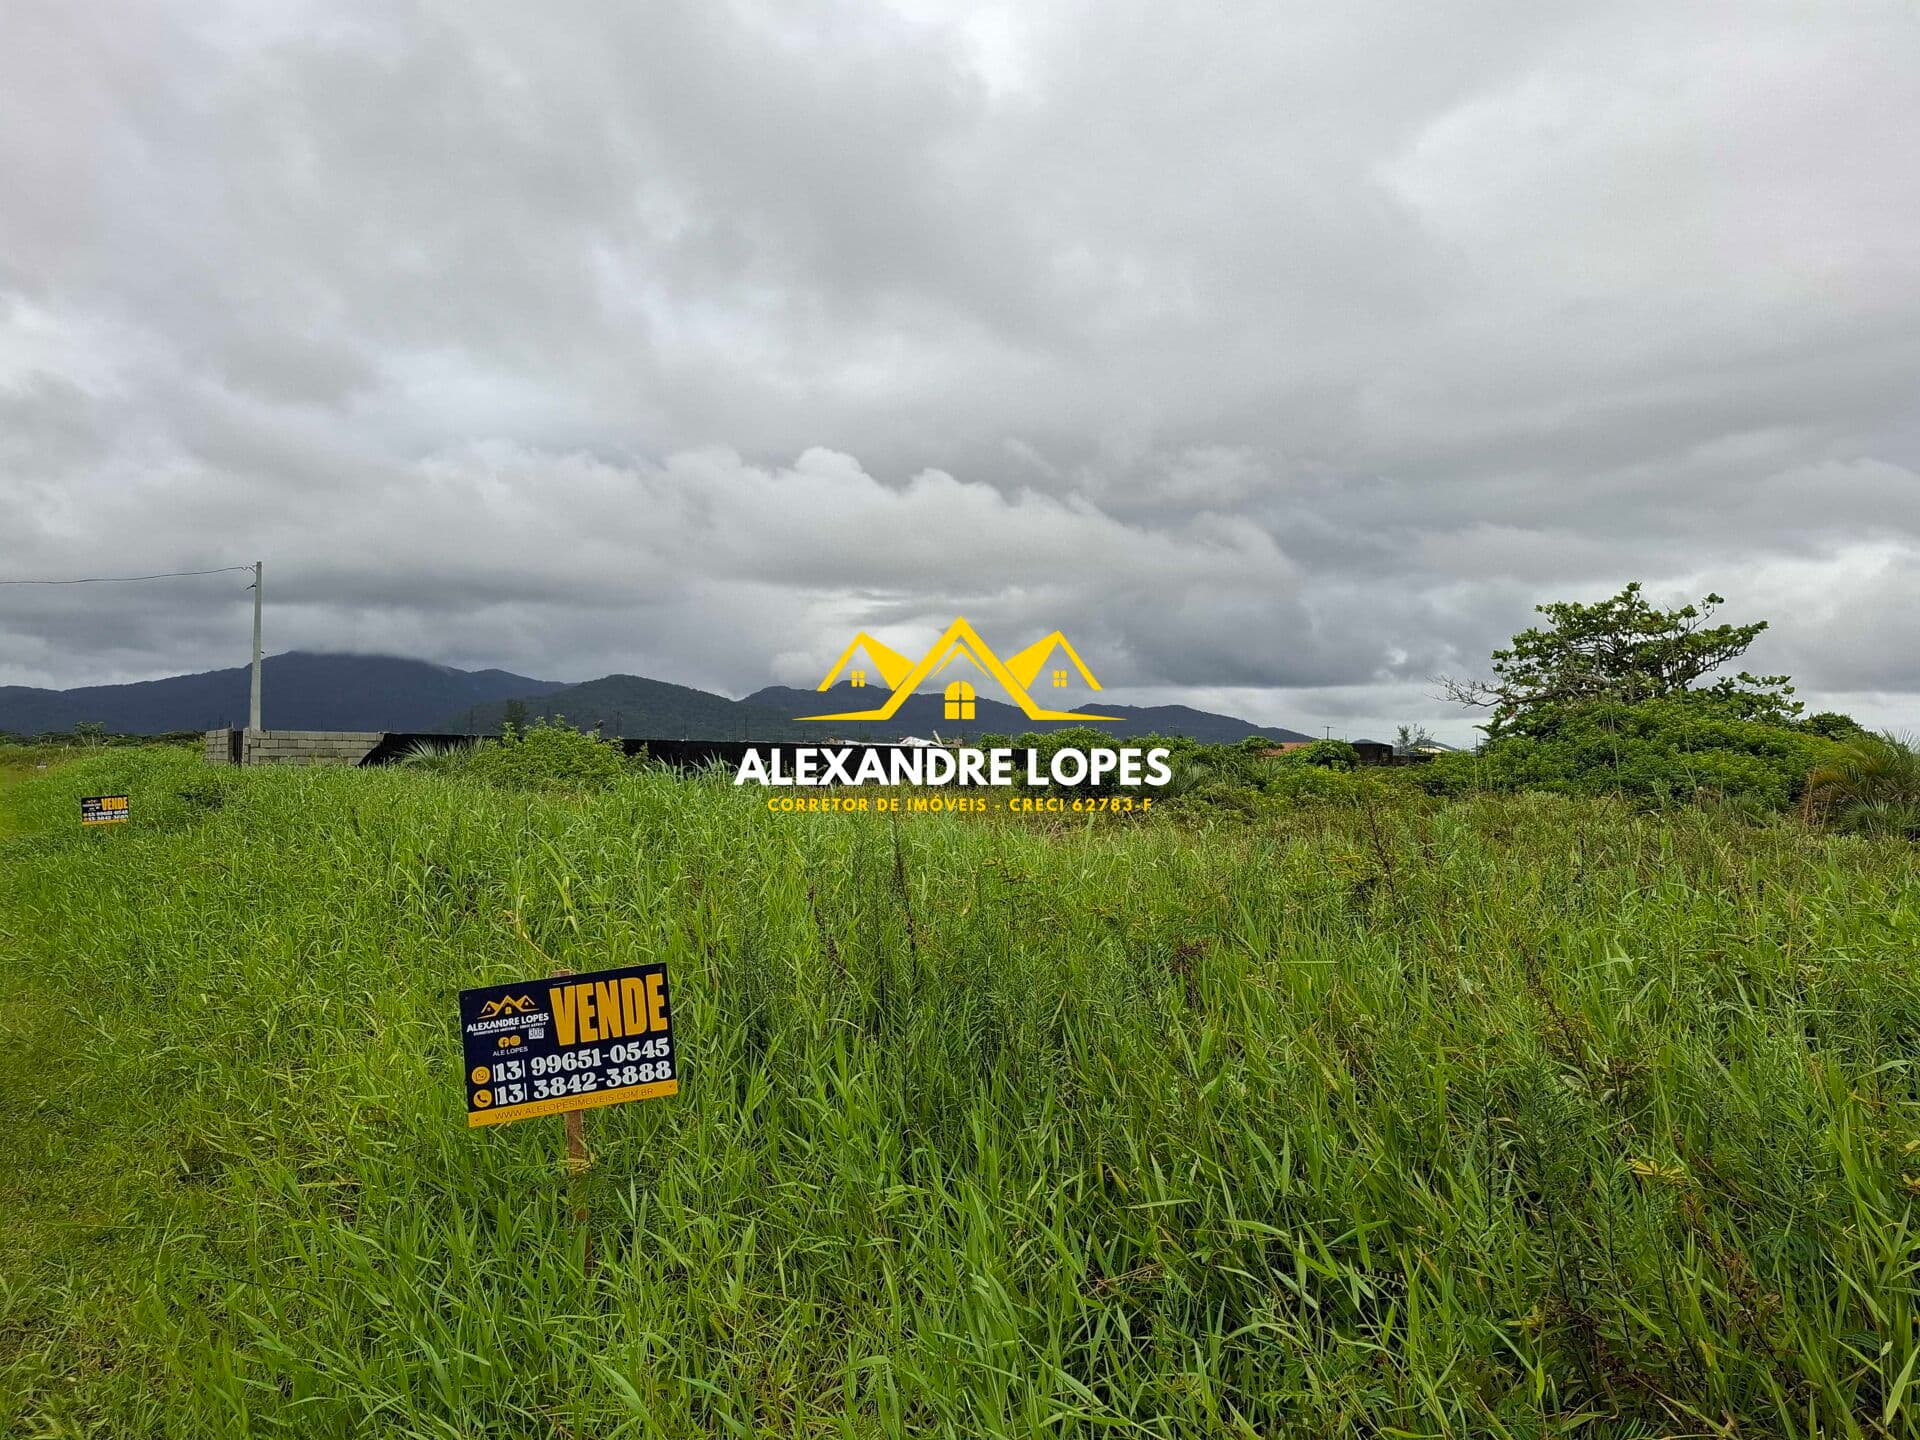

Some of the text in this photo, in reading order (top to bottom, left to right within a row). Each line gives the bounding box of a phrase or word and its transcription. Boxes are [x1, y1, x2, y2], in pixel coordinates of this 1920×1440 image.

[466, 1017, 520, 1033] ALEXANDRE
[521, 1012, 550, 1025] LOPES
[549, 974, 667, 1046] VENDE
[492, 1046, 529, 1057] ALE LOPES
[531, 1038, 670, 1076] 99651-0545
[533, 1061, 672, 1100] 3842-3888
